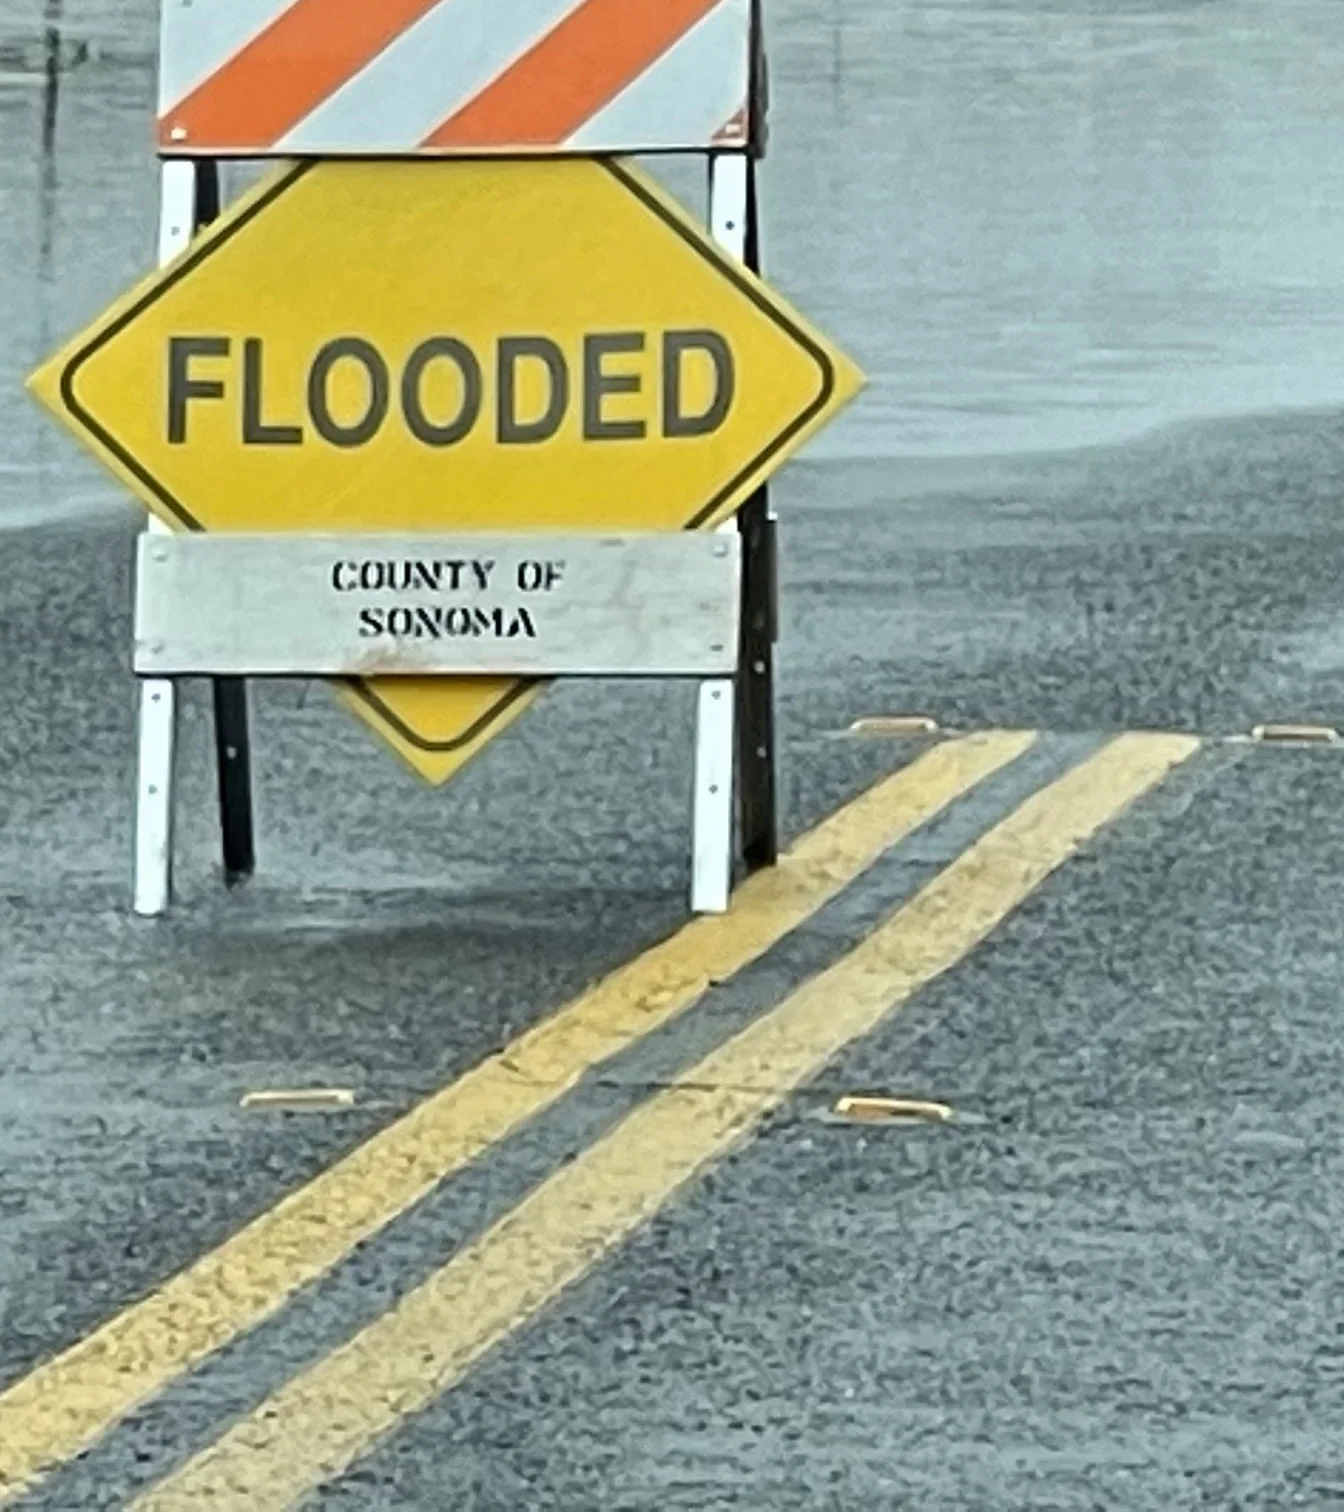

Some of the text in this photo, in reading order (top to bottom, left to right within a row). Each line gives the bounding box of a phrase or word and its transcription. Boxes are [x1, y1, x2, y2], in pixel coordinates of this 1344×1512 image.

[167, 329, 735, 448] FLOODED
[331, 559, 565, 591] COUNTY OF
[358, 606, 537, 638] SONOMA
